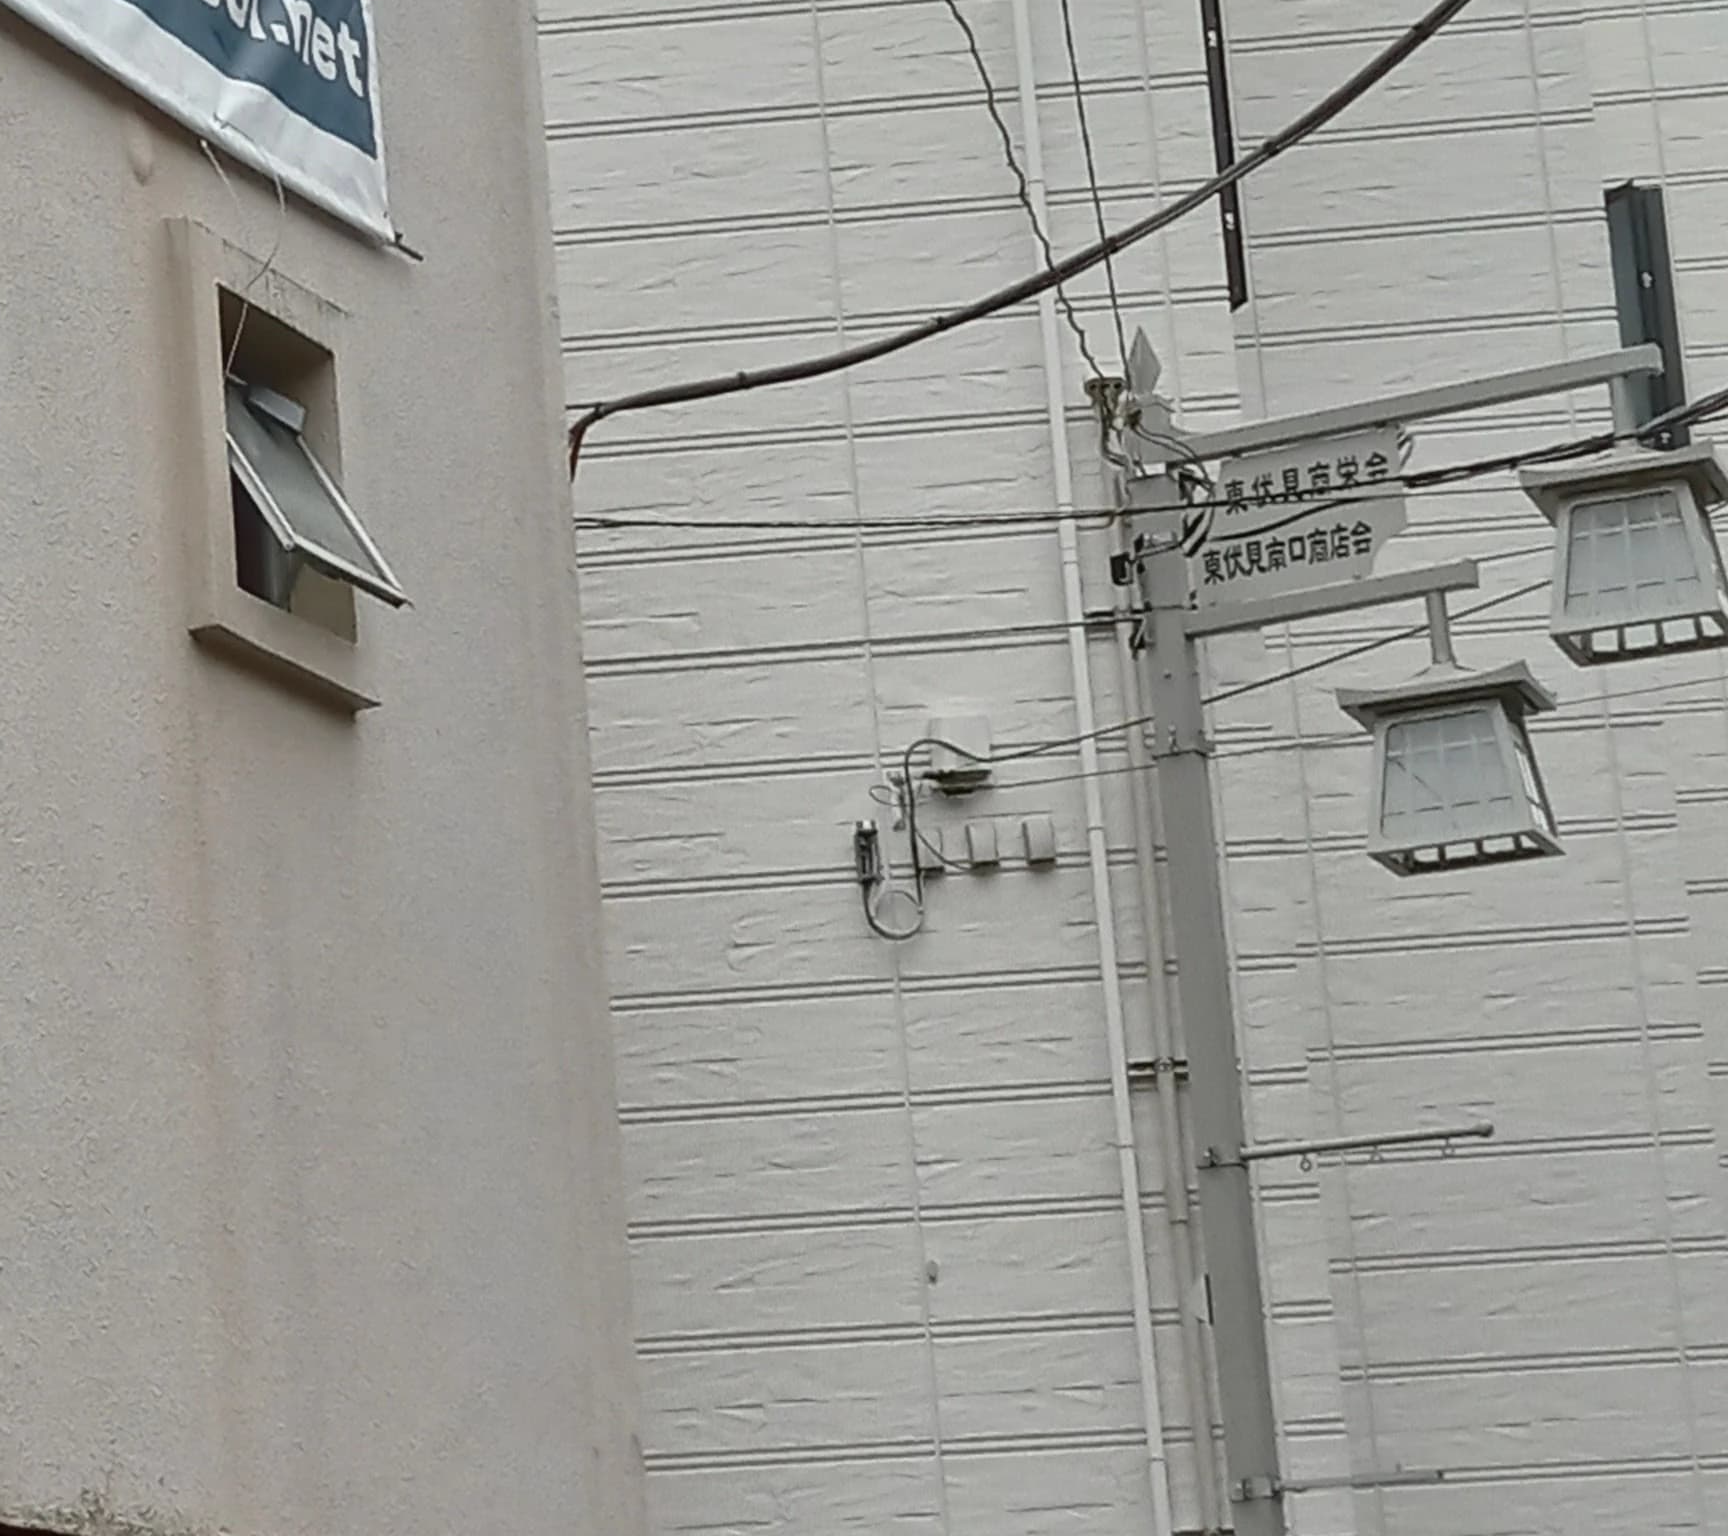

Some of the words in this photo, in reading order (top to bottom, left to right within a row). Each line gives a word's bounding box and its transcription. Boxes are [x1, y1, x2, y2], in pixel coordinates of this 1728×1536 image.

[1202, 521, 1373, 585] 東伏見南口商店会
